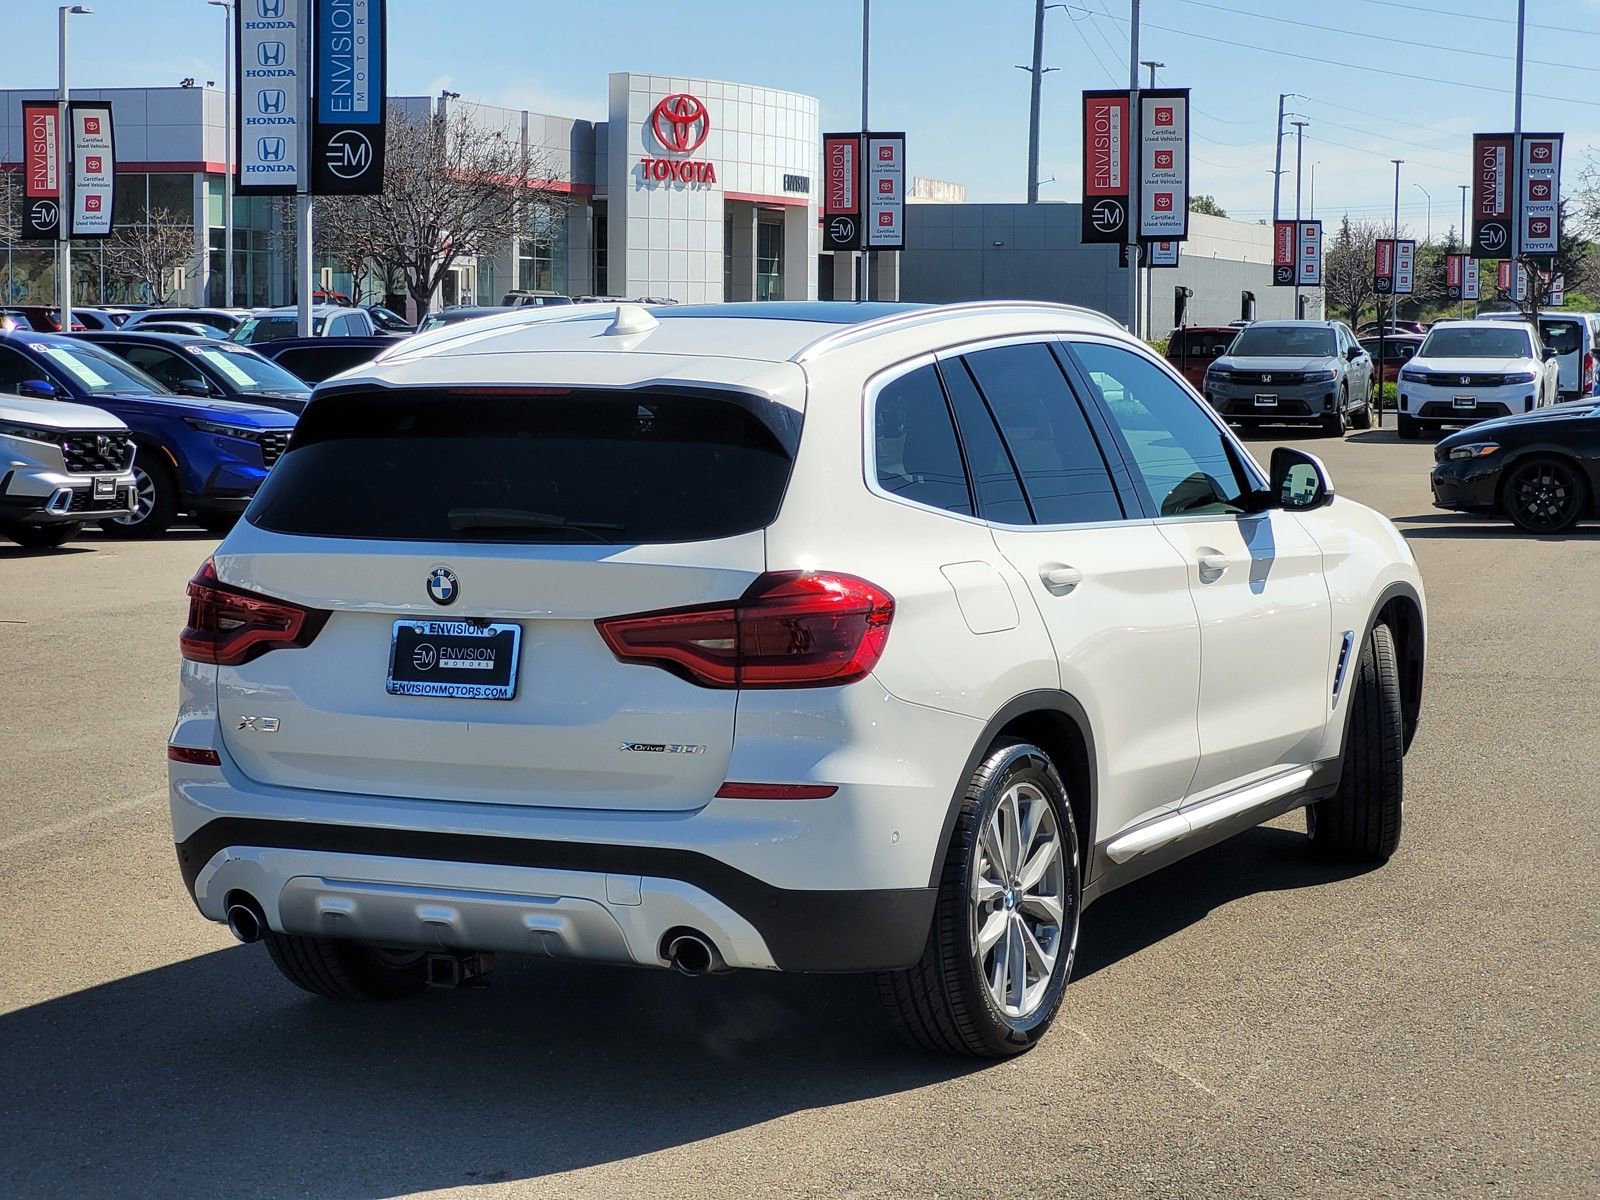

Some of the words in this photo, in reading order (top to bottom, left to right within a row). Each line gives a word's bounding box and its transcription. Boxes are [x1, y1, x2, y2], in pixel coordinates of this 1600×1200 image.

[246, 22, 296, 30] HONDA
[356, 1, 366, 102] MOTORS
[246, 70, 296, 78] HONDA
[246, 117, 296, 125] HONDA
[33, 114, 46, 190] ENVISION
[1095, 106, 1109, 188] ENVISION
[246, 165, 296, 173] HONDA
[641, 158, 717, 184] TOYOTA
[832, 144, 844, 209] ENVISION
[1483, 146, 1496, 214] ENVISION
[429, 623, 484, 635] ENVISION
[439, 647, 496, 660] ENVISION
[392, 682, 508, 697] ENVISIONMOTORS.COM
[237, 715, 281, 732] X3
